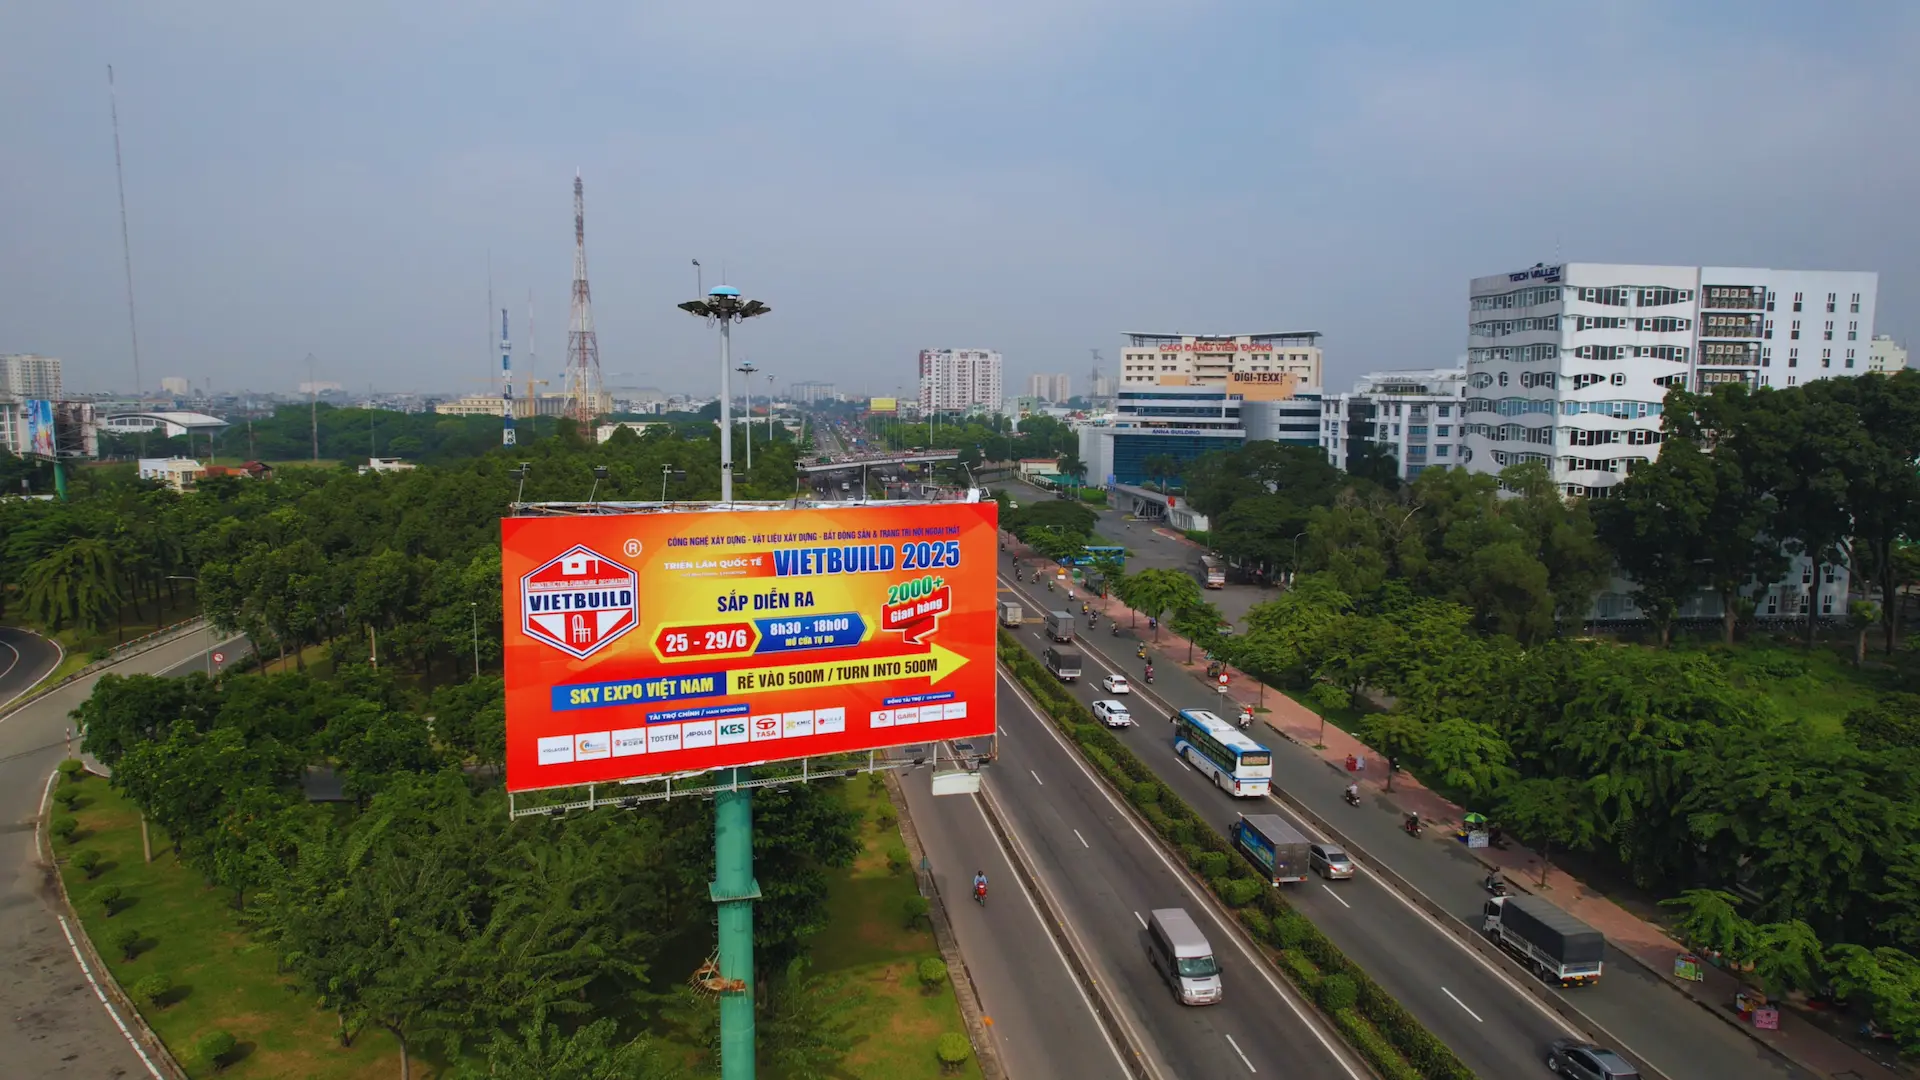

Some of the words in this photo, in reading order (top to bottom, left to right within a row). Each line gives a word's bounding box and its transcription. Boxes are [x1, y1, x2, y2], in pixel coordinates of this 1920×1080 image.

[1509, 272, 1529, 282] TECH
[1531, 266, 1560, 279] VALLEY
[1160, 344, 1182, 352] CAO
[1234, 372, 1280, 382] DIGI-TEXX
[668, 536, 688, 546] CÔNG
[690, 535, 708, 547] NGHỆ
[711, 535, 724, 545] XÂY
[726, 534, 746, 546] DỰNG
[752, 532, 766, 544] VẬT
[767, 532, 782, 544] LIỆU
[784, 532, 797, 542] XÂY
[798, 532, 817, 543] DỰNG
[720, 556, 748, 568] QUỐC
[750, 556, 762, 566] TẾ
[773, 544, 895, 577] VIETBUILD
[902, 540, 960, 570] 2025
[888, 576, 944, 605] 2000+
[529, 590, 631, 611] VIETBUILD
[718, 590, 748, 612] SẮP
[754, 588, 789, 610] DIỄN
[795, 592, 814, 607] RA
[891, 608, 914, 623] Gian
[916, 598, 942, 615] hàng
[770, 622, 800, 636] 8h30
[813, 618, 849, 632] 18h00
[666, 634, 688, 652] 25
[705, 630, 747, 650] 29/6
[738, 673, 754, 690] RẼ
[759, 671, 784, 688] VÀO
[788, 669, 824, 684] 500M
[836, 666, 869, 680] TURN
[874, 663, 900, 676] INTO
[905, 658, 938, 674] 500M
[570, 688, 599, 704] SKY
[604, 684, 642, 701] EXPO
[646, 679, 676, 699] VIỆT
[680, 678, 713, 694] NAM
[678, 709, 700, 718] CHÍNH
[650, 734, 678, 742] TOSTEM
[686, 729, 712, 738] APOLLO
[720, 724, 745, 736] KES
